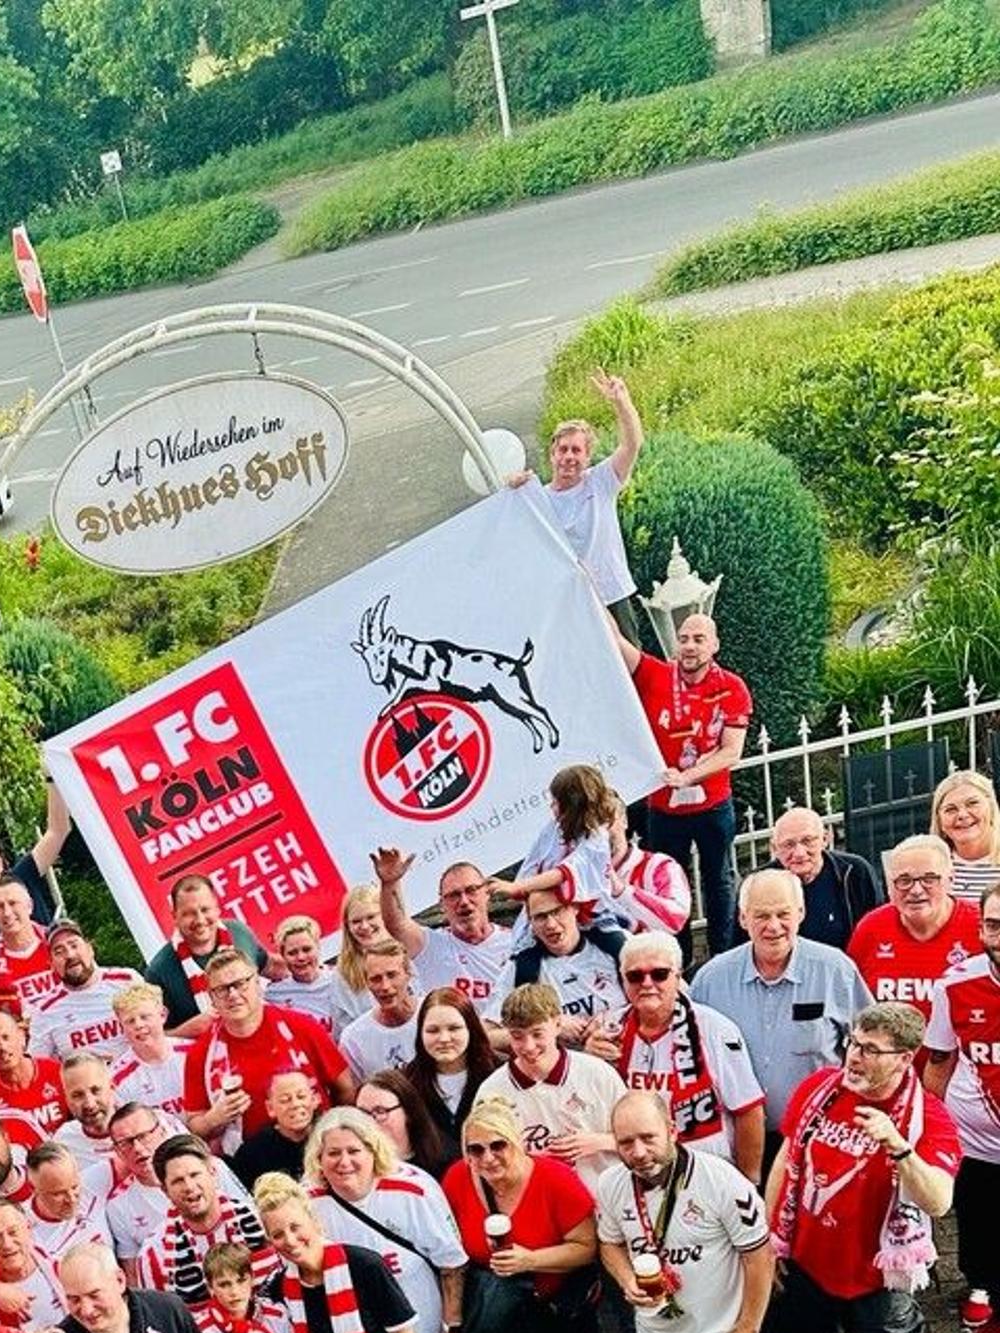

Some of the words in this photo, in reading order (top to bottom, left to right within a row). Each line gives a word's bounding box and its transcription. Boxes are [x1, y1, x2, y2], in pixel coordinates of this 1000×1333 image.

[97, 446, 143, 487] Auf
[146, 415, 260, 468] Wiedersehen
[262, 416, 285, 433] im
[245, 432, 329, 502] Hoff
[124, 746, 261, 840] KÖLN
[417, 756, 465, 808] KÖLN
[140, 782, 275, 865] FANCLUB
[225, 863, 319, 924] TTEN
[877, 977, 938, 1002] REW
[70, 1018, 124, 1050] REW
[630, 1072, 676, 1092] EW
[30, 1102, 62, 1126] WE
